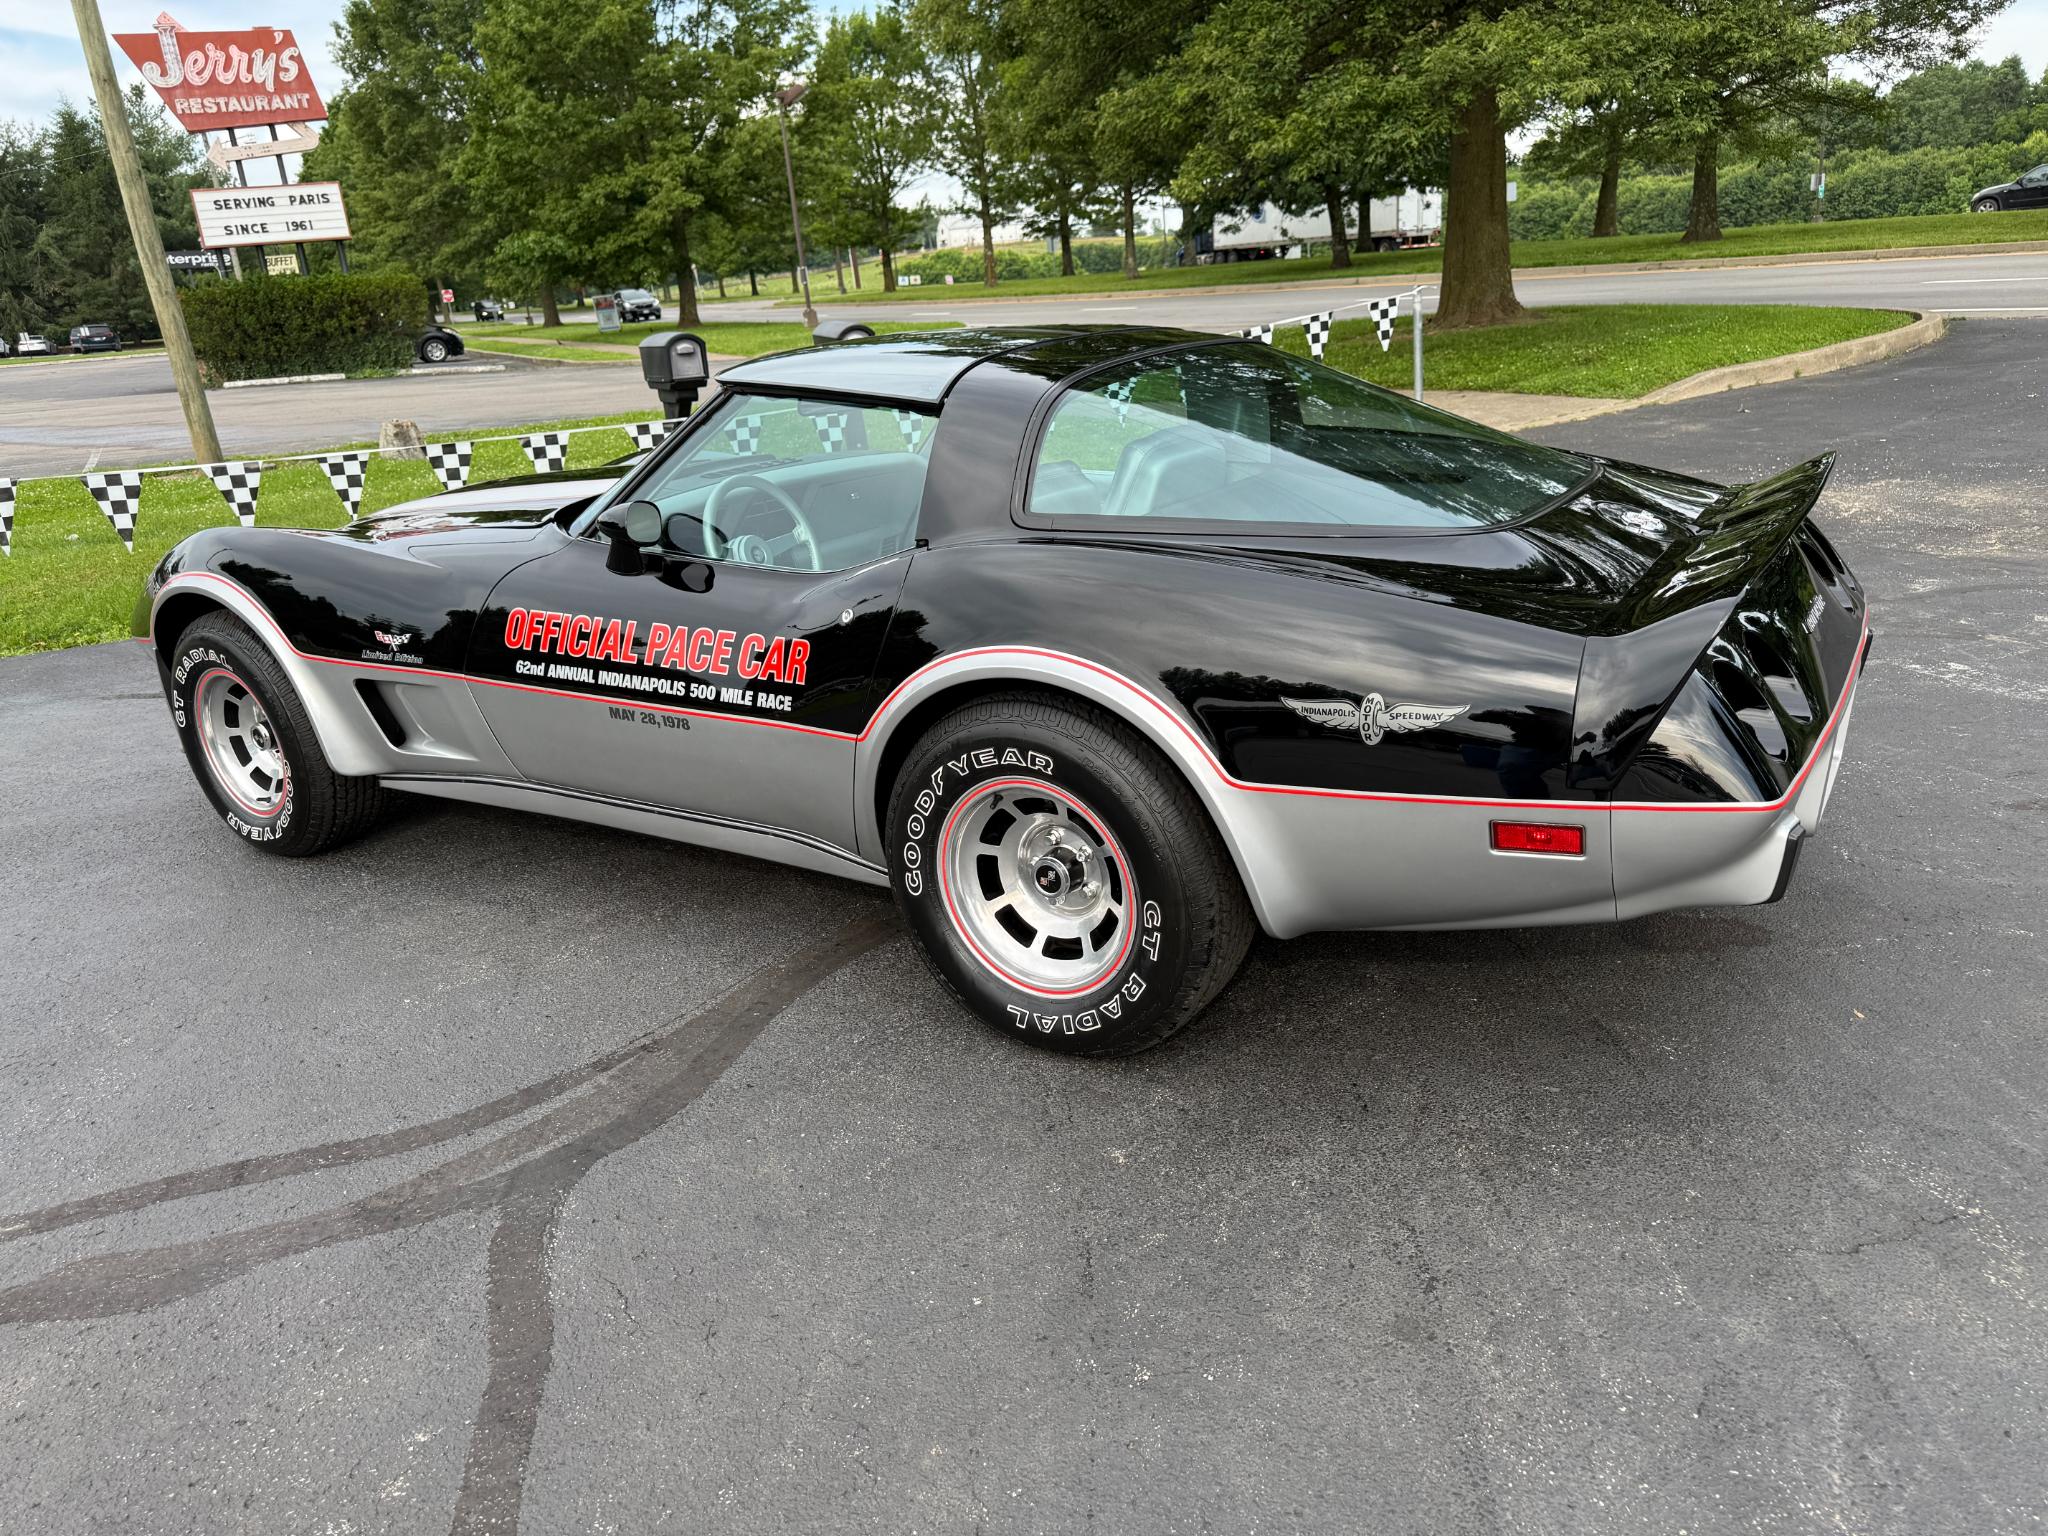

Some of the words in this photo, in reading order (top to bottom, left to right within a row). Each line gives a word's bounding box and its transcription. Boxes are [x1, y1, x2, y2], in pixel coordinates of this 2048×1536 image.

[142, 24, 299, 92] Jerry's
[175, 93, 310, 115] RESTAURANT
[213, 196, 275, 211] SERVING
[289, 193, 330, 206] PARIS
[224, 222, 270, 236] SINCE
[286, 219, 313, 232] 1961
[266, 255, 294, 267] BUFFET
[175, 647, 234, 684] RADIAL
[361, 649, 394, 661] Limited
[504, 607, 637, 665] OFFICIAL
[644, 622, 737, 676] PACE
[737, 633, 811, 686] CAR
[515, 659, 545, 676] 62nd
[547, 663, 595, 684] ANNUAL
[598, 670, 685, 696] INDIANAPOLIS
[689, 683, 716, 701] 500
[720, 687, 753, 706] MILE
[757, 692, 793, 712] RACE
[173, 690, 186, 728] GT
[608, 706, 636, 722] MAY
[1301, 705, 1356, 718] INDIANAPOLIS
[1362, 697, 1375, 742] MOTOR
[1388, 712, 1444, 721] SPEEDWAY
[903, 747, 1054, 896] GOODYEAR
[1142, 900, 1161, 962] GT
[1007, 972, 1147, 1034] RADIAL
